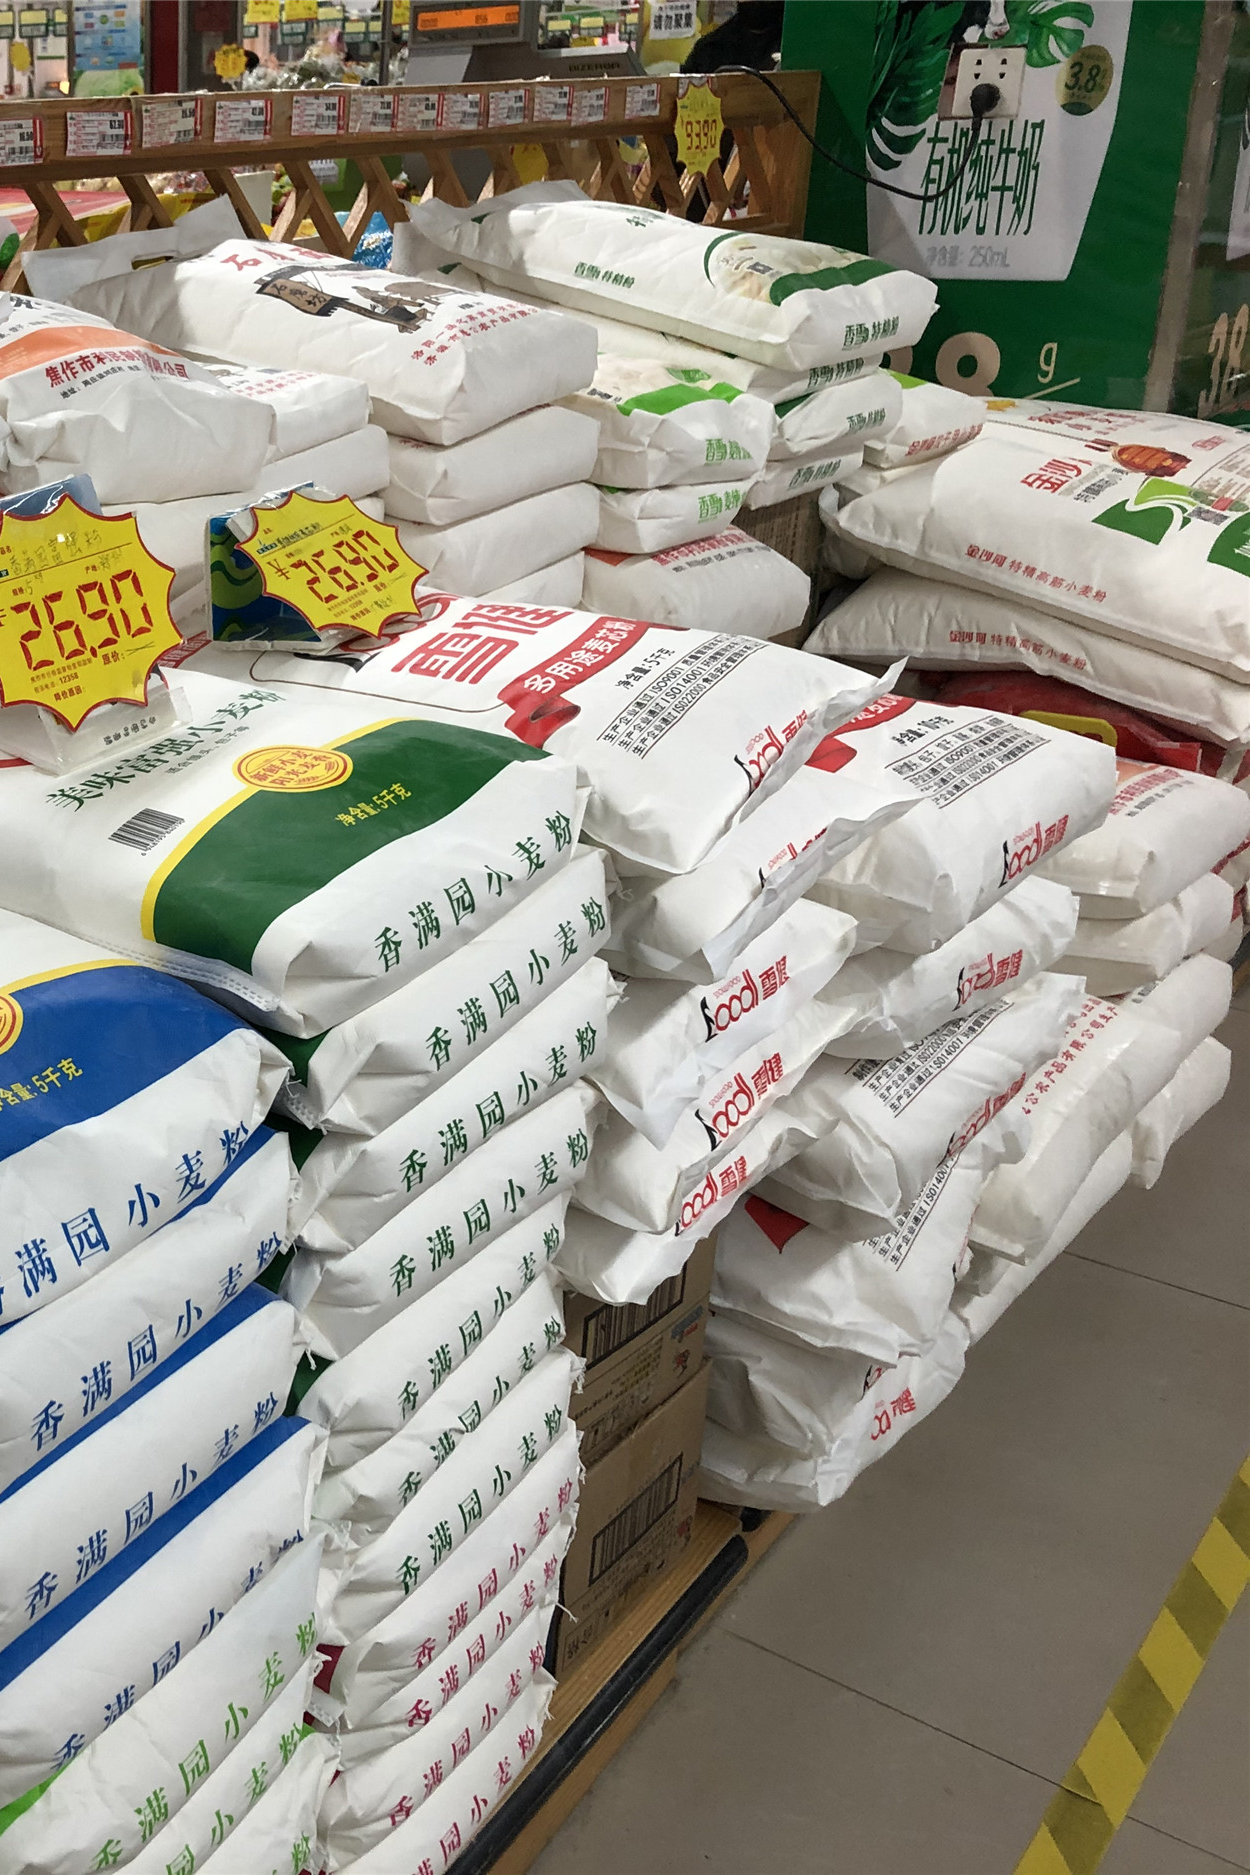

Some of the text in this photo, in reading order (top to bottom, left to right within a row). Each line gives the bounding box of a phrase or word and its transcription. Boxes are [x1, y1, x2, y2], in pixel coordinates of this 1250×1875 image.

[918, 118, 1046, 237] 有机纯牛奶
[10, 569, 154, 671] 26.90
[290, 530, 400, 604] 26.90
[1009, 558, 1108, 603] 特精高筋小麦粉
[59, 671, 80, 684] 12358
[523, 619, 638, 694] 多用途麦芯粉
[603, 666, 685, 743] 生产企业通过 ISO9001
[614, 647, 677, 691] 净含量:5千克
[618, 667, 705, 750] 生产企业通过 ISO14001
[990, 632, 1088, 671] 特精高筋小麦粉
[45, 687, 288, 813] 美味富强小麦粉
[632, 711, 678, 757] 生产企业通过
[334, 782, 412, 827] 净含量:5千克
[374, 810, 572, 973] 香满园小麦粉
[425, 896, 607, 1072] 香满园小麦粉
[399, 1021, 597, 1193] 香满园小麦粉
[391, 1128, 589, 1298] 香满园小麦粉
[30, 1231, 282, 1452] 香满园小麦粉
[397, 1223, 563, 1420] 香满园小麦粉
[25, 1391, 280, 1620] 香满园小麦粉
[396, 1403, 562, 1596] 香满园小麦粉
[413, 1476, 574, 1671] 香满园小麦粉
[406, 1553, 558, 1729] 香满园小麦粉
[388, 1641, 545, 1828] 香满园小麦粉
